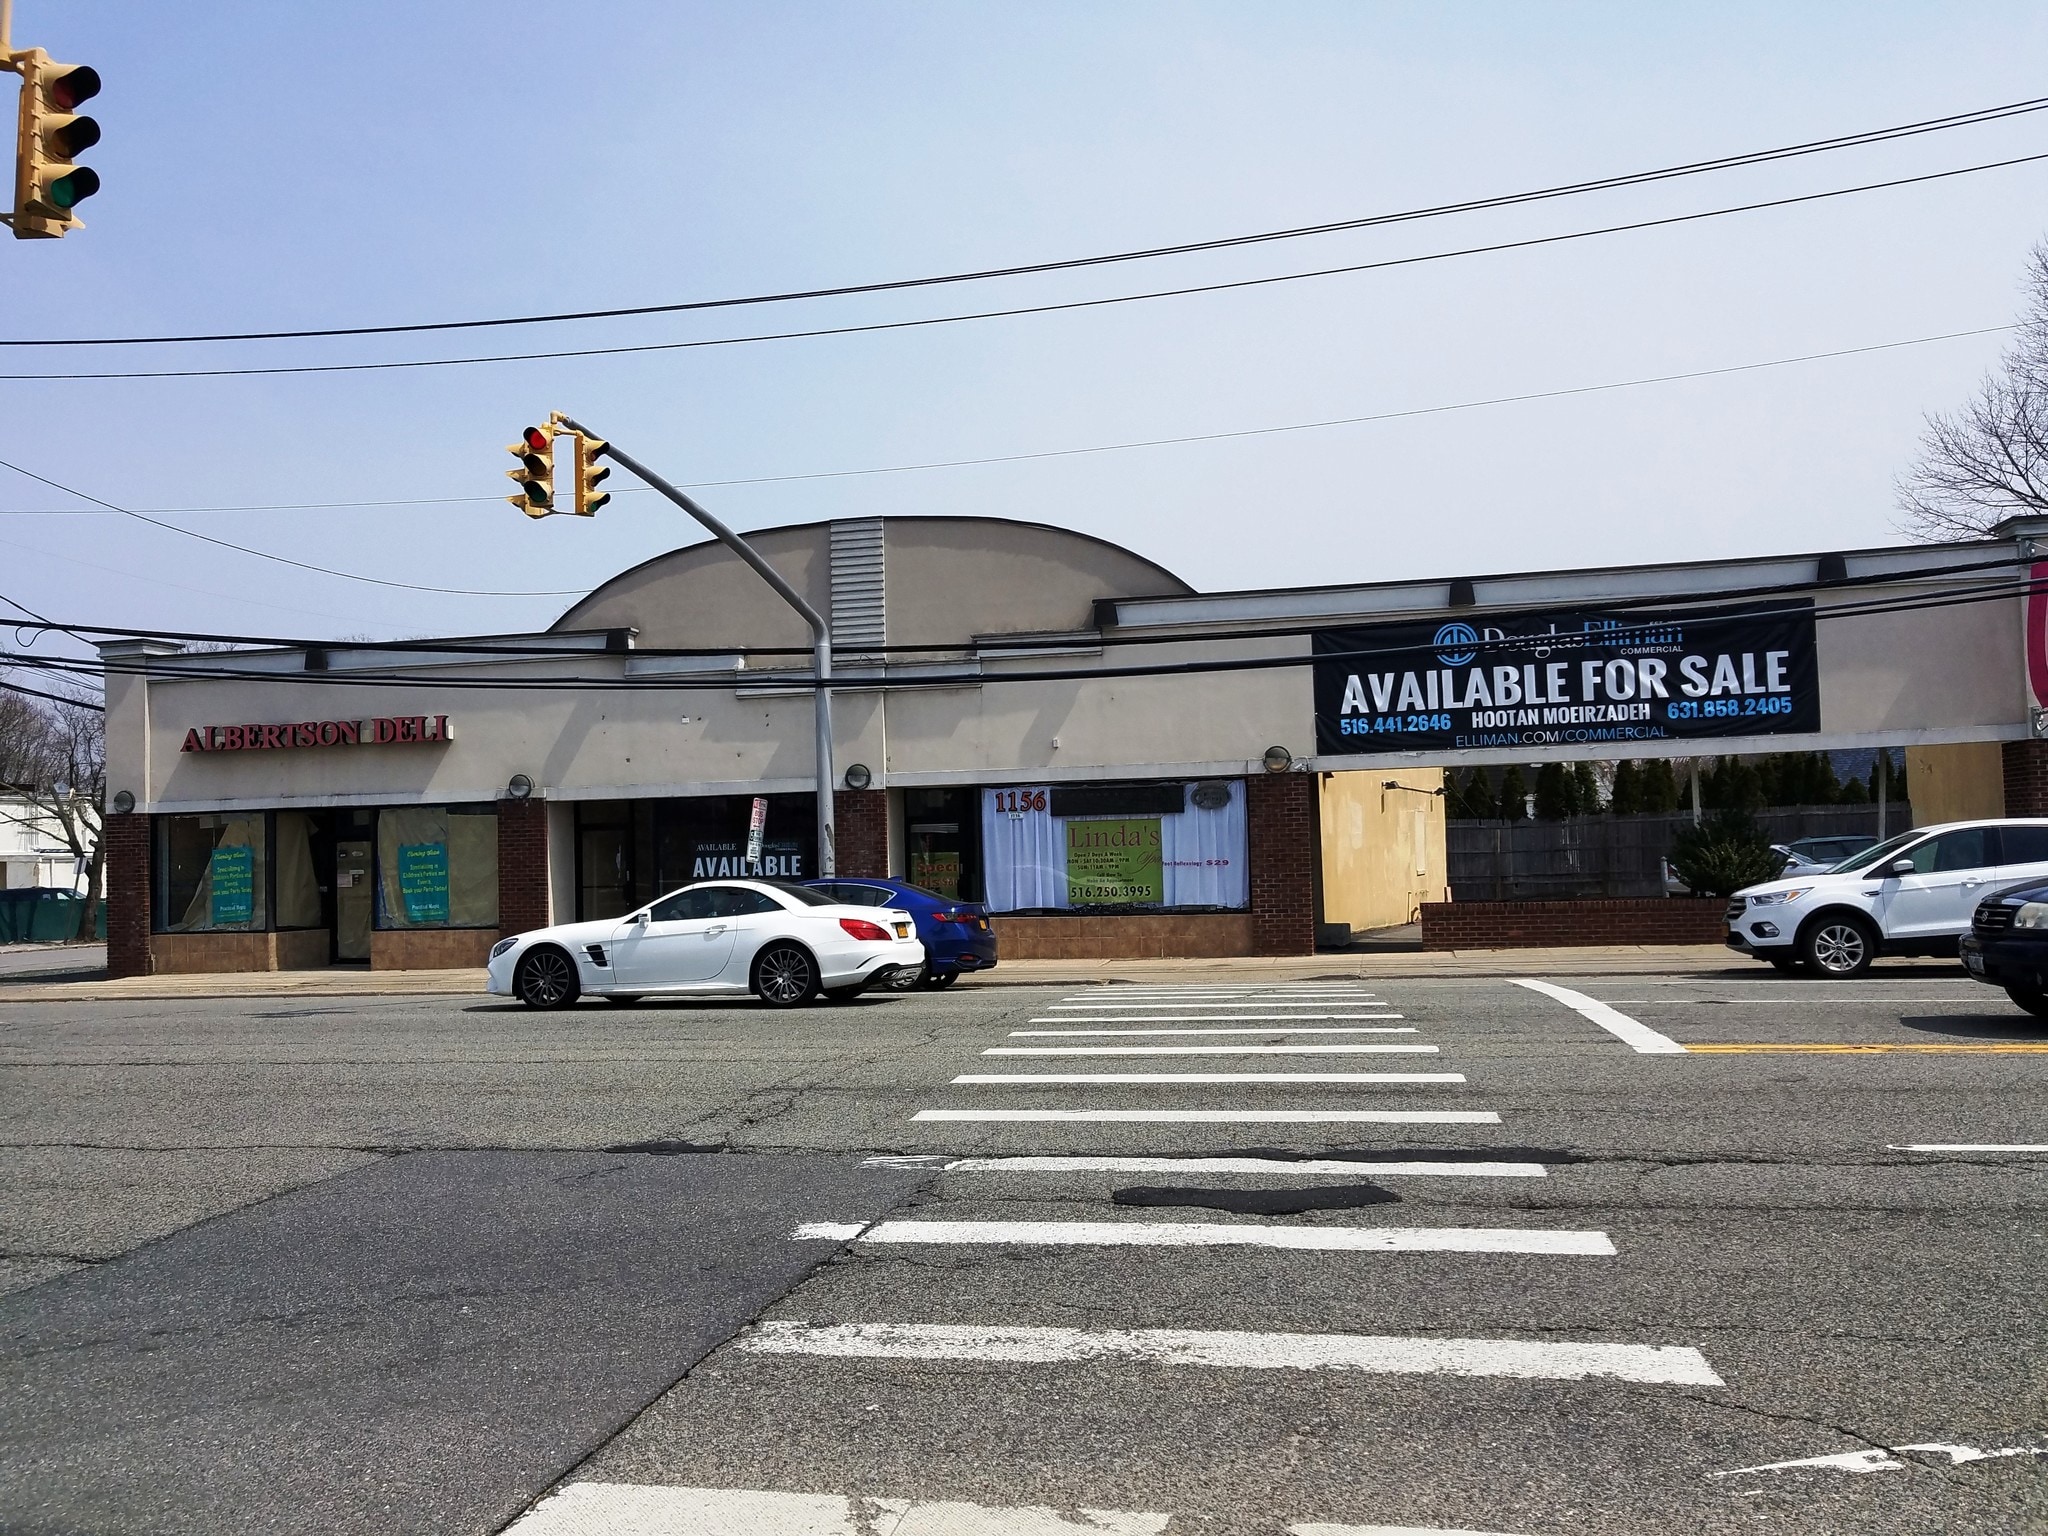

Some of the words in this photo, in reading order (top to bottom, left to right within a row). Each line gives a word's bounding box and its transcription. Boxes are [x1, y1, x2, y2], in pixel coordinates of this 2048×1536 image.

[1620, 645, 1683, 655] COMMERCIAL
[1340, 662, 1570, 714] AVAILABLE
[1581, 658, 1669, 701] FOR
[1679, 650, 1791, 697] SALE
[1471, 708, 1539, 728] HOOTAN
[1543, 703, 1651, 725] MOEIRZADEH
[1667, 696, 1792, 719] 631.858.2405
[180, 720, 360, 752] ALBERTSON
[371, 715, 449, 744] DELI
[1340, 714, 1451, 735] 516.441.2646
[1456, 726, 1668, 747] ELLIMAN.COM/COMMERCIAL
[995, 790, 1046, 812] 1156
[696, 843, 737, 851] AVAILABLE
[1070, 824, 1159, 848] Linda's
[693, 855, 802, 877] AVAILABLE
[1071, 885, 1151, 898] 516.250.3995
